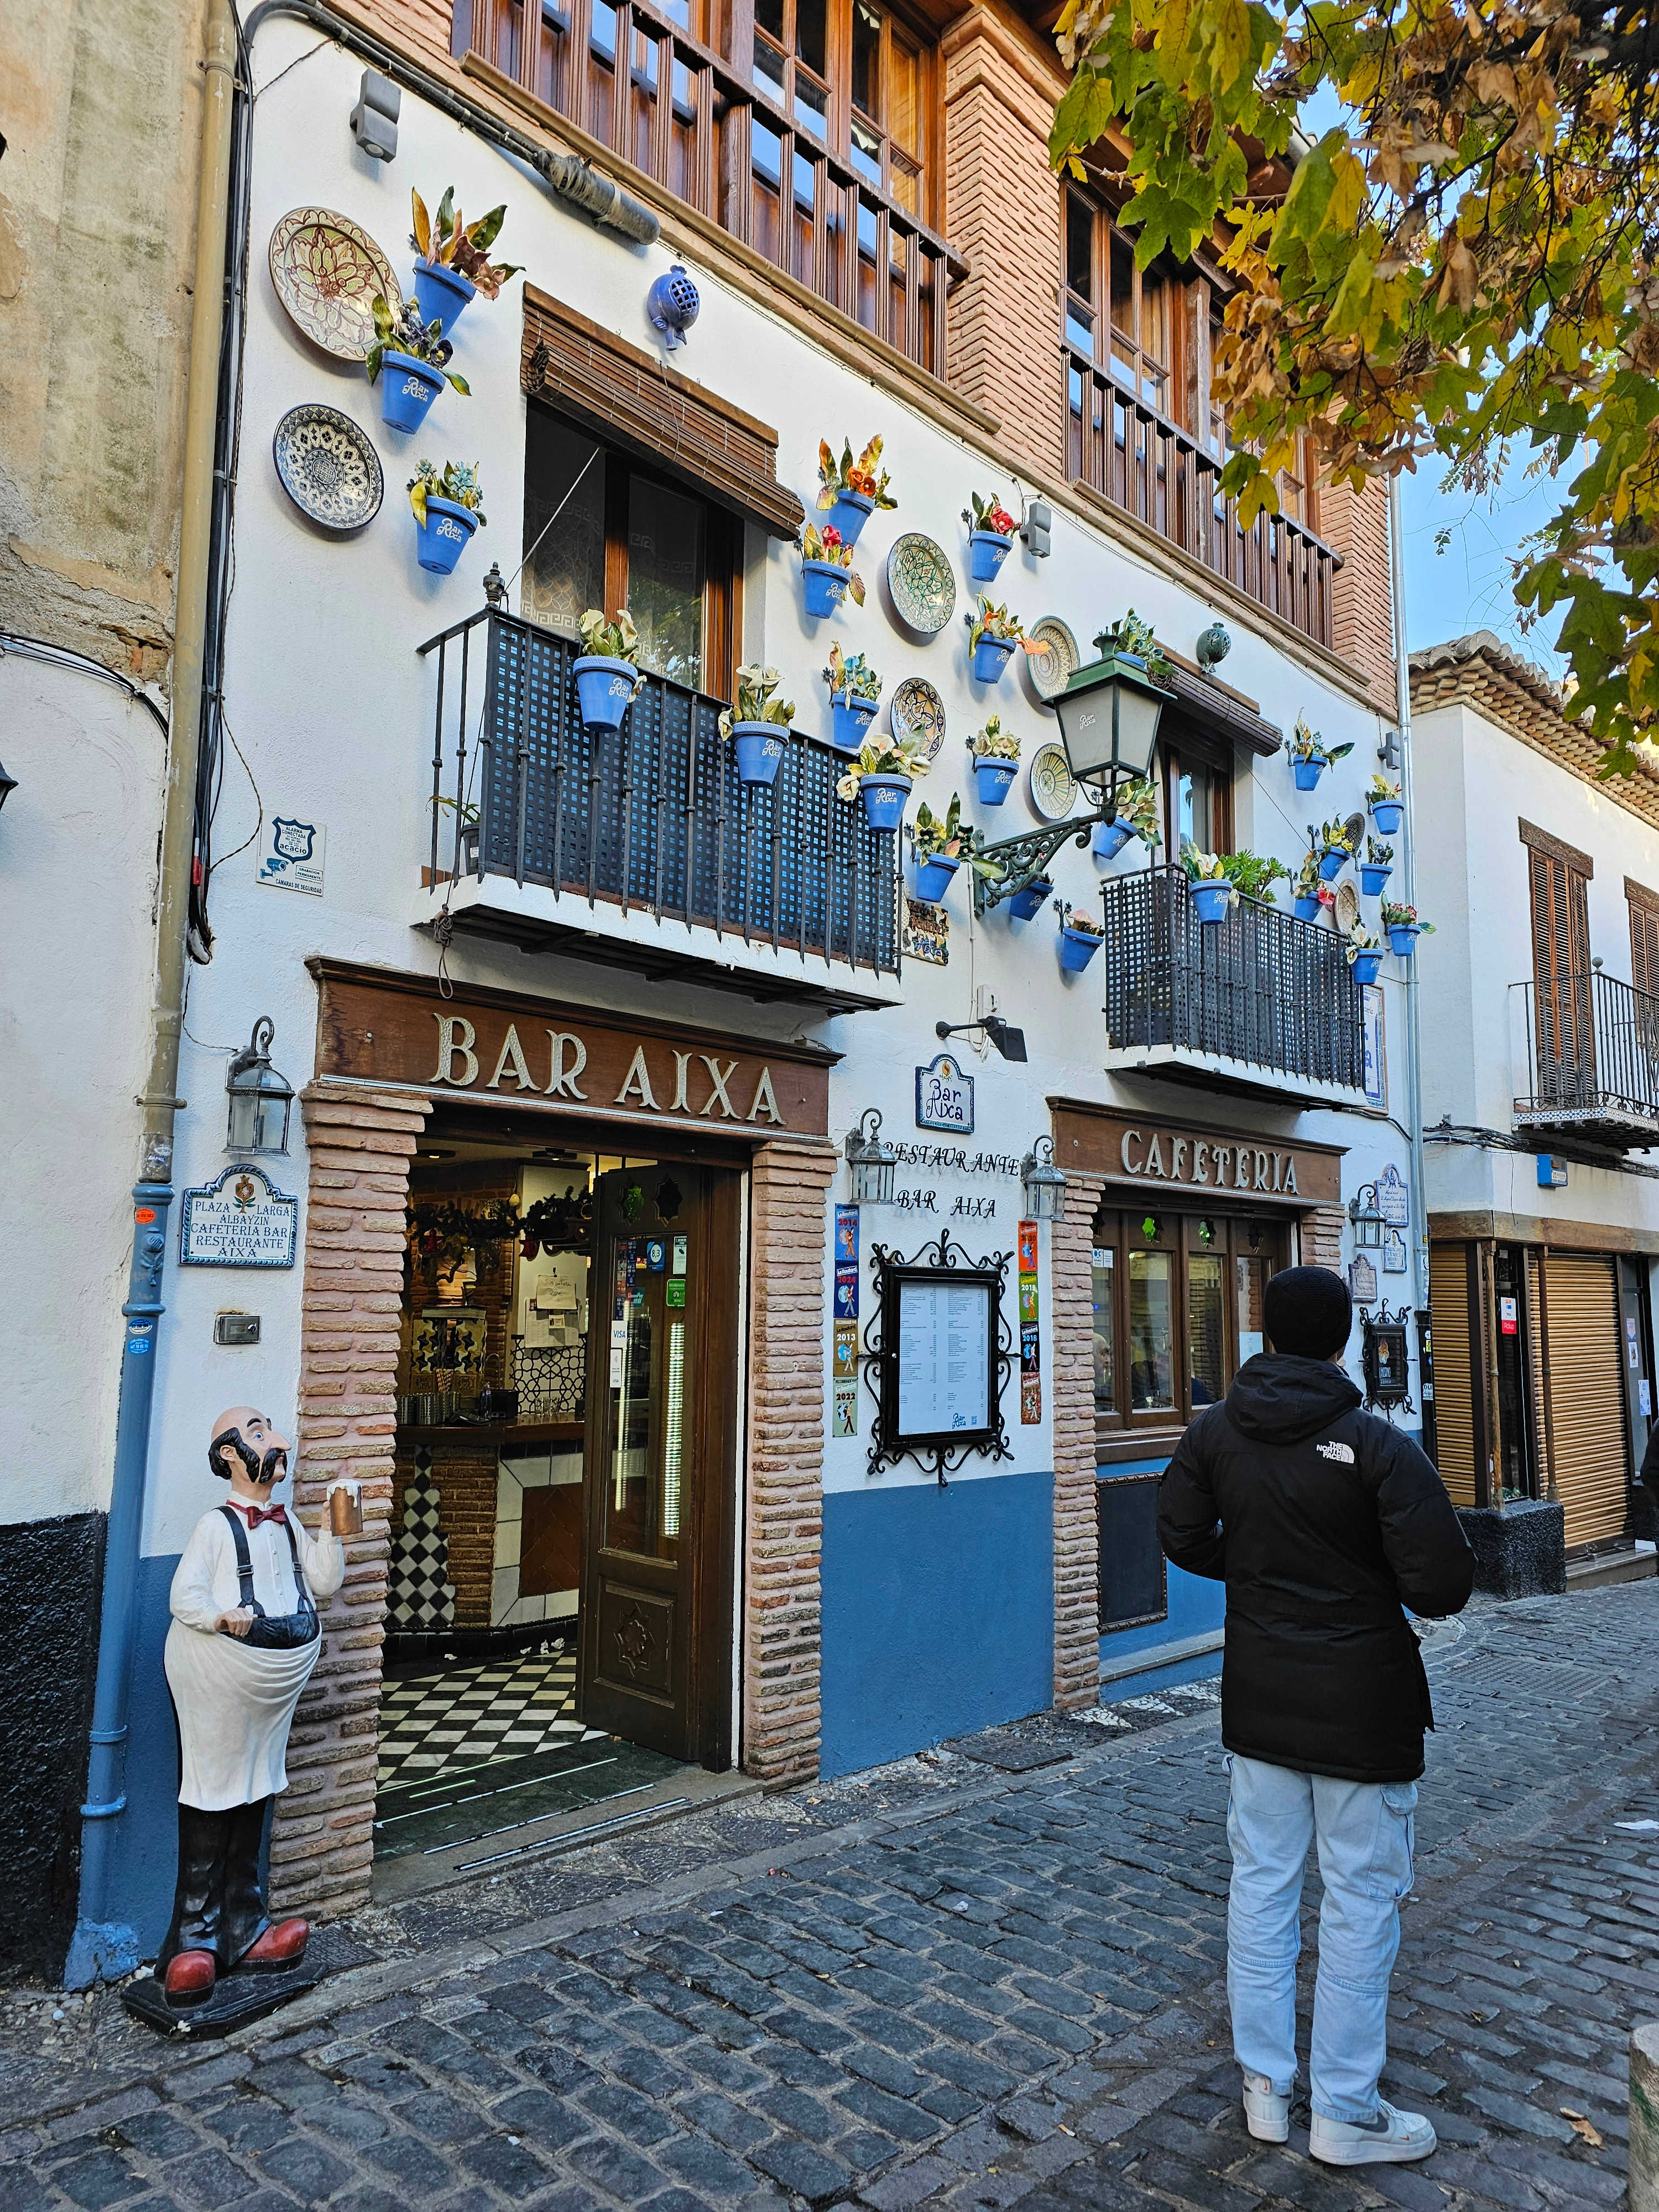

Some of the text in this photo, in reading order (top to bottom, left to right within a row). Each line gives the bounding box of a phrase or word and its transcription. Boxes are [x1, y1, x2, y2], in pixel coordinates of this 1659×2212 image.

[408, 377, 429, 394] Bar
[442, 518, 462, 535] Bar
[1080, 714, 1094, 723] Bar
[877, 787, 896, 798] Bar
[282, 830, 306, 838] CONECTADA
[279, 844, 307, 854] acacio
[297, 872, 321, 880] PERMANENTE
[300, 884, 322, 894] SEGURIDAD
[429, 1013, 787, 1125] BAR AIXA
[930, 1078, 961, 1102] Bar
[926, 1090, 963, 1120] Aixa
[1121, 1130, 1301, 1194] CAFETERIA
[195, 1201, 290, 1216] PLAZA LARGA
[896, 1189, 996, 1218] BAR AIXA
[838, 1218, 857, 1227] 2014
[191, 1223, 287, 1238] CAFETERIA BAR
[196, 1235, 284, 1249] RESTAURANTE
[217, 1247, 257, 1258] AIXA
[651, 1249, 660, 1258] 8,3
[613, 1330, 626, 1338] VISA
[836, 1392, 855, 1401] 2022
[953, 1412, 966, 1422] Bar
[1316, 1444, 1342, 1456] NORTH
[1329, 1441, 1343, 1449] THE
[1323, 1451, 1342, 1461] FACE
